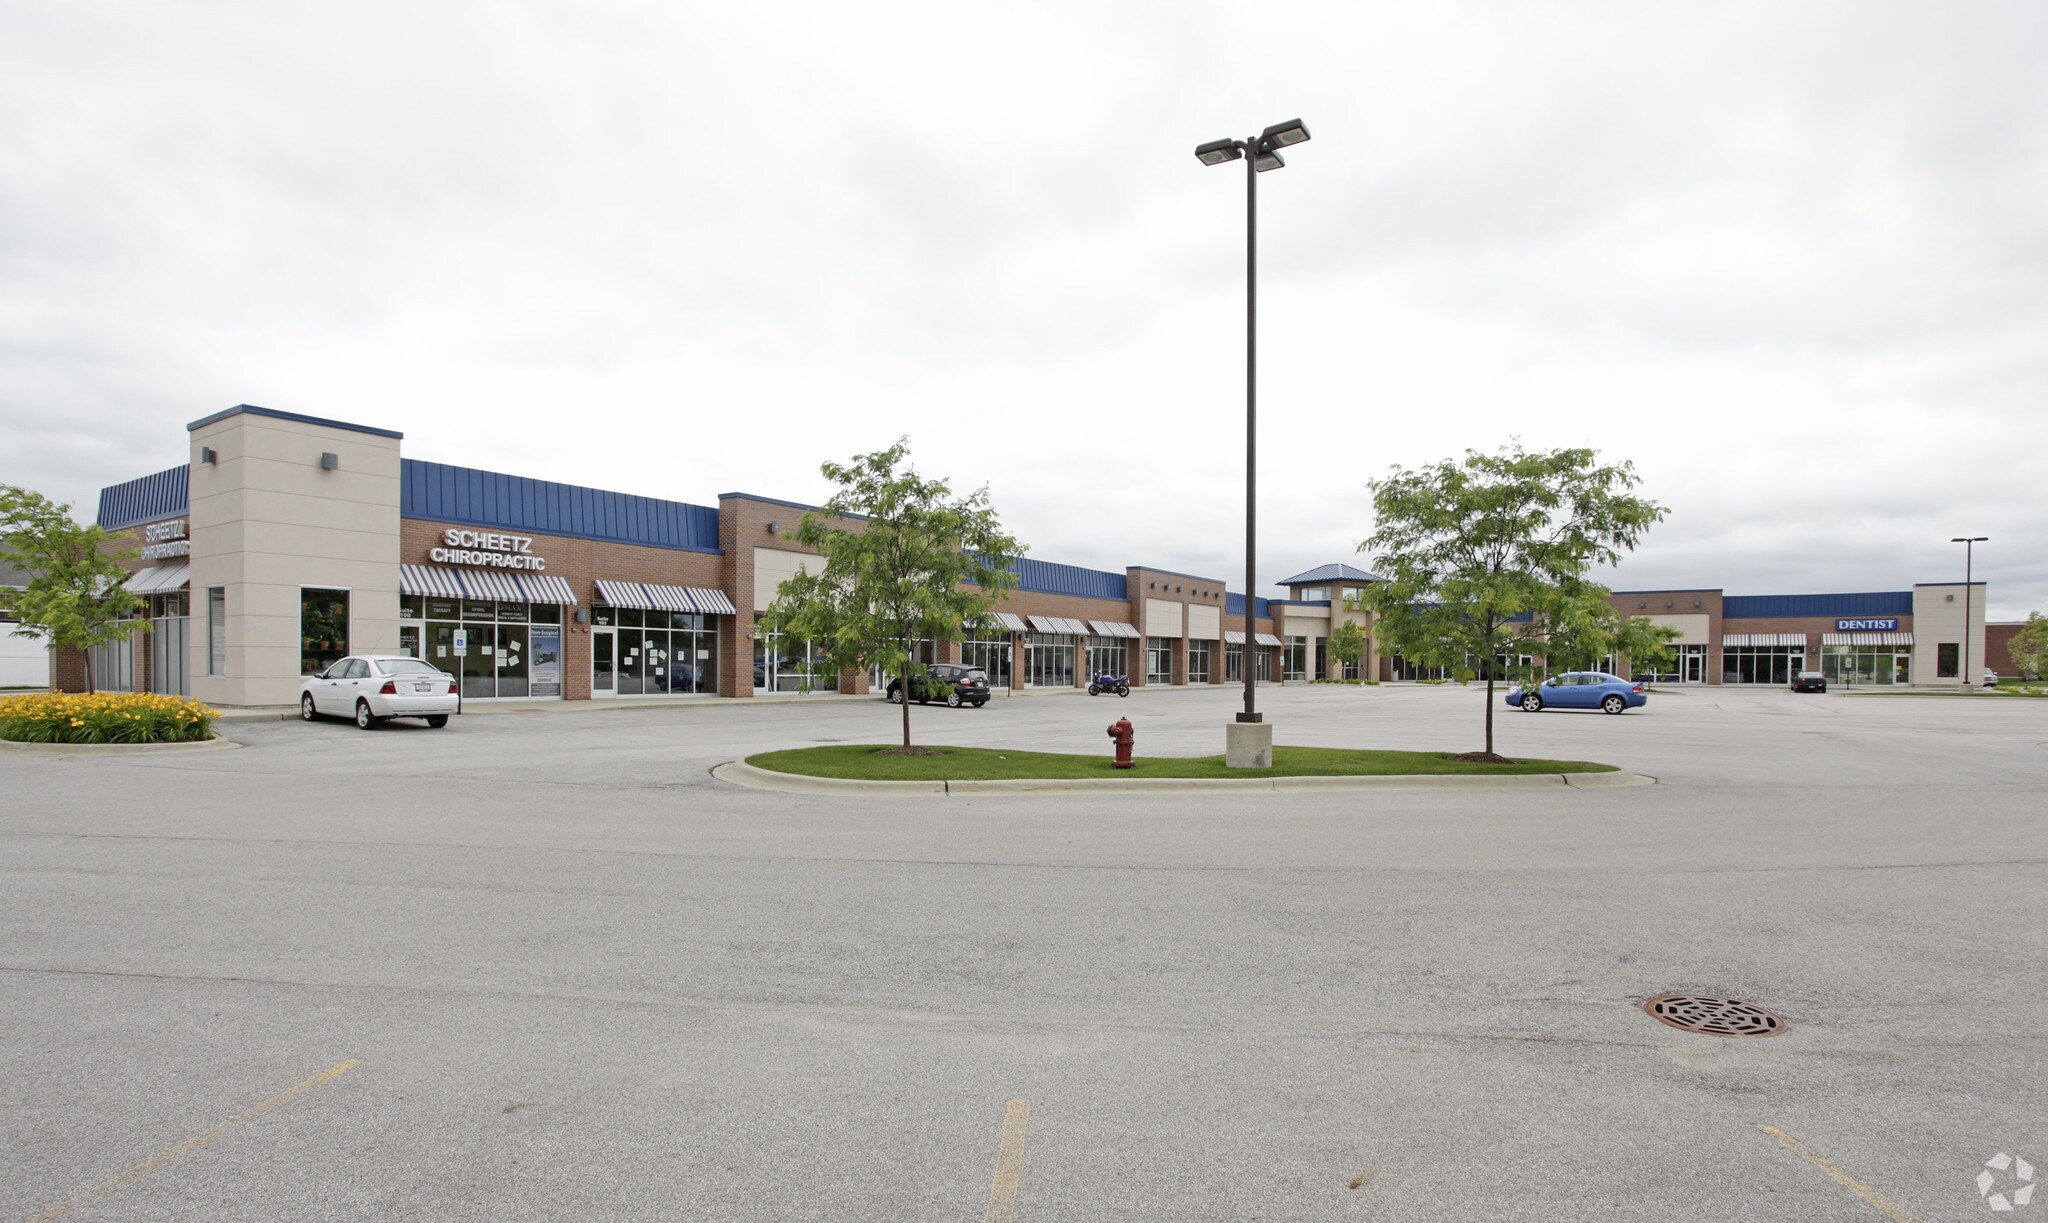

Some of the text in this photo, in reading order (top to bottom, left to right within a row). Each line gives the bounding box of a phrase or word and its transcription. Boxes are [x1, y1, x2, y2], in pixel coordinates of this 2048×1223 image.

[146, 520, 185, 542] SCHEETZ
[445, 529, 533, 553] SCHEETZ
[430, 547, 545, 571] CHIROPRACTIC
[1838, 619, 1895, 629] DENTIST
